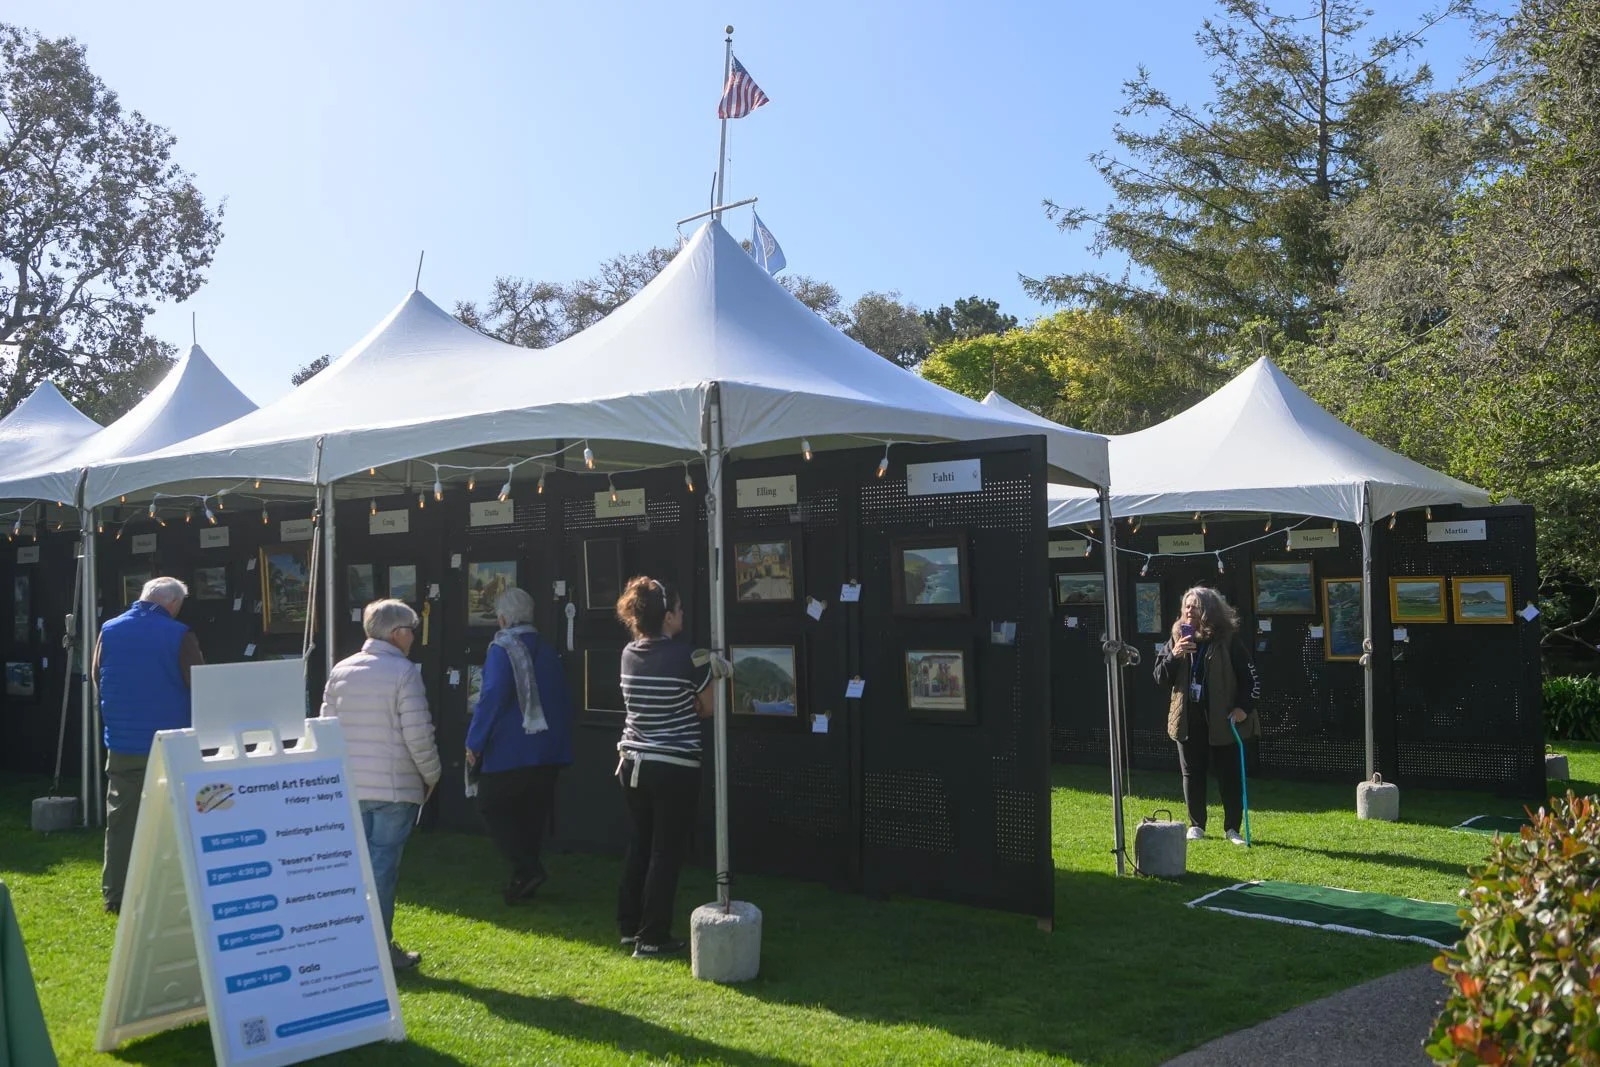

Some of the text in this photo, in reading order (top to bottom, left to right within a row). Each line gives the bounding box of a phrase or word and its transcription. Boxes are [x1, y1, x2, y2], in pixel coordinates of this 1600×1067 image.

[932, 471, 955, 483] Fahti
[756, 487, 777, 498] Elling
[1444, 526, 1469, 535] Martin
[238, 774, 340, 794] Carmel Art Festival
[285, 795, 310, 805] Friday
[317, 793, 334, 803] May
[336, 791, 343, 800] 15
[276, 821, 345, 838] Paintings Arriving
[244, 833, 258, 844] pm
[316, 849, 352, 861] Paintings
[212, 873, 218, 881] 2
[218, 873, 231, 882] pm
[255, 866, 268, 876] pm
[285, 887, 356, 905] Awards Ceremony
[218, 907, 223, 915] 4
[224, 906, 238, 917] pm
[261, 899, 275, 909] pm
[290, 915, 365, 934] Purchase Paintings
[223, 938, 229, 946] 4
[230, 936, 243, 947] pm
[250, 928, 280, 941] Onward
[299, 963, 321, 975] Gala
[243, 977, 257, 989] pm
[268, 972, 283, 983] pm
